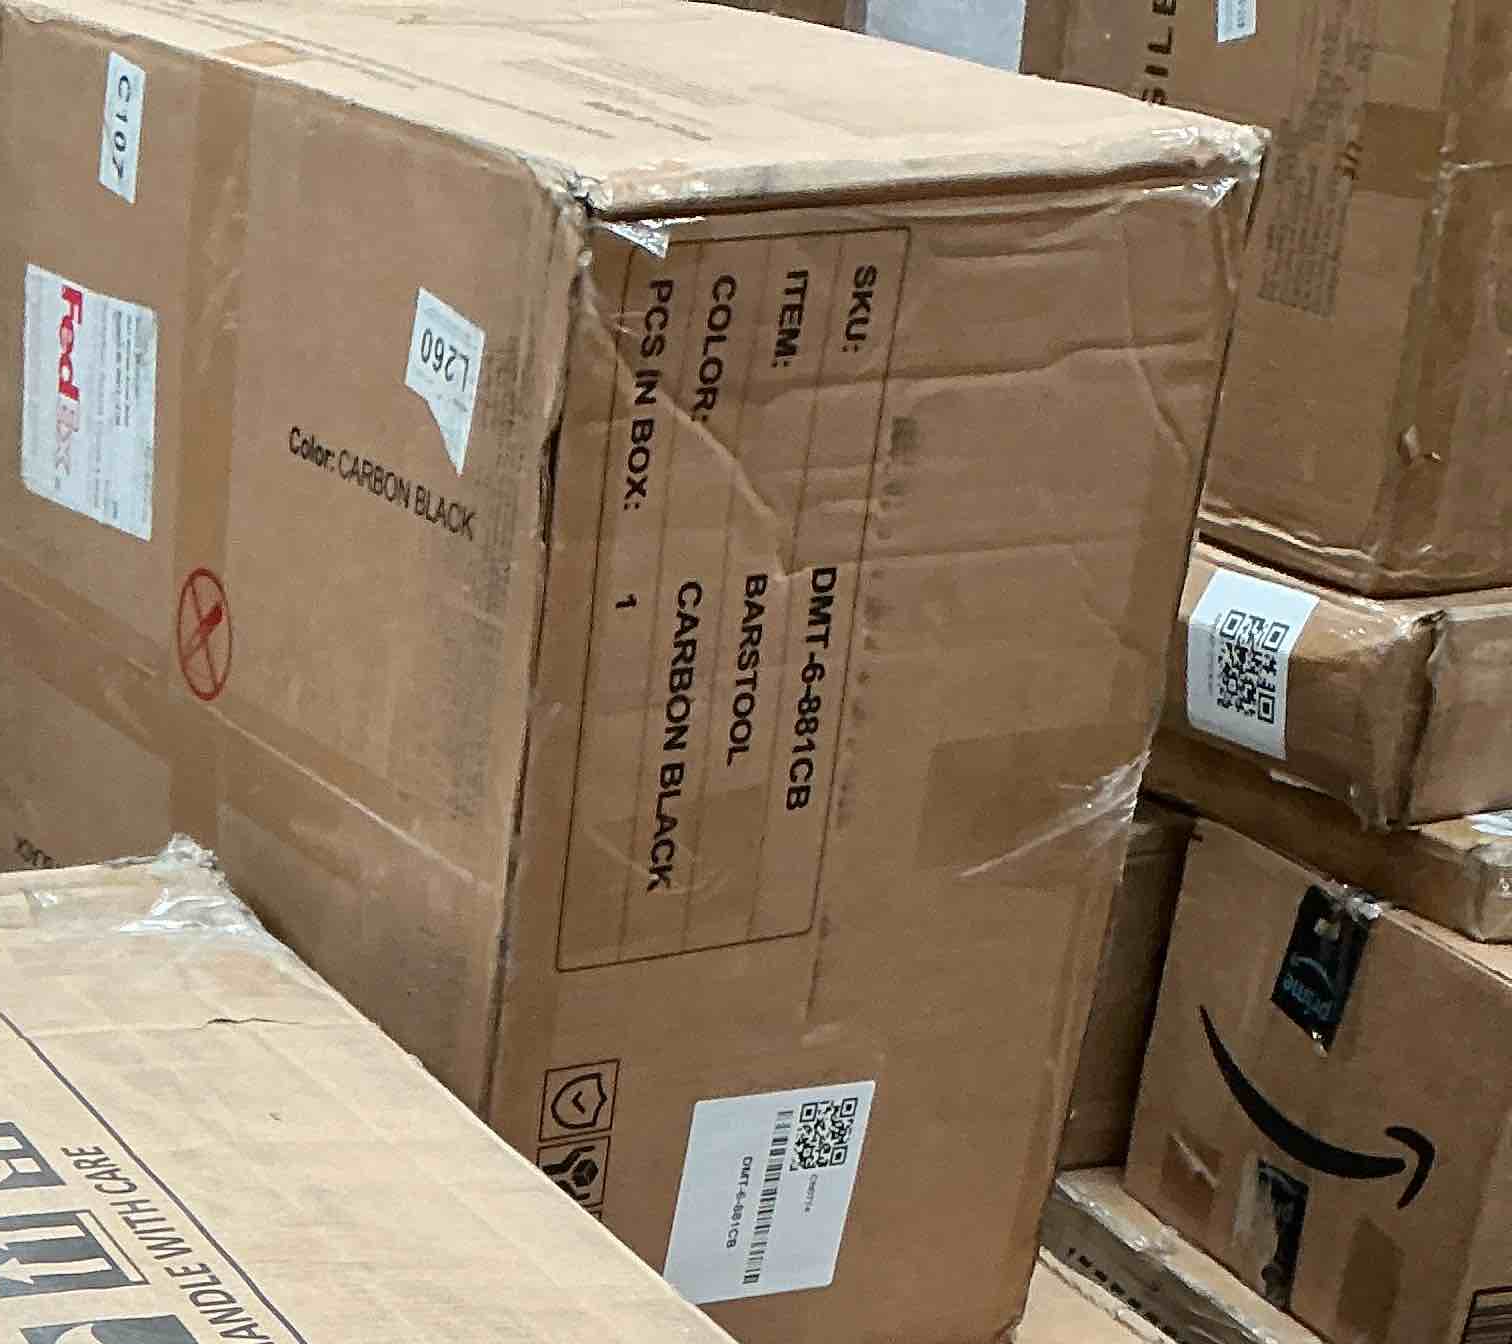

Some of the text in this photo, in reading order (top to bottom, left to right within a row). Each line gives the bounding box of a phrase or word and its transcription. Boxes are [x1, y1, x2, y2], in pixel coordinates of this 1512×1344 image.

[691, 273, 737, 423] COLOR:
[770, 269, 810, 369] ITEM:
[841, 264, 879, 354] SKU:
[55, 284, 83, 477] FedEx
[623, 280, 675, 510] PCS IN BOX:
[339, 450, 410, 509] CARBON
[414, 486, 477, 541] BLACK
[615, 595, 638, 610] 1
[726, 573, 768, 767] BARSTOOL
[786, 566, 837, 811] DMT-6-881CB
[647, 582, 703, 893] CARBON BLACK
[60, 1145, 138, 1196] CARE
[110, 1199, 193, 1261] WITH
